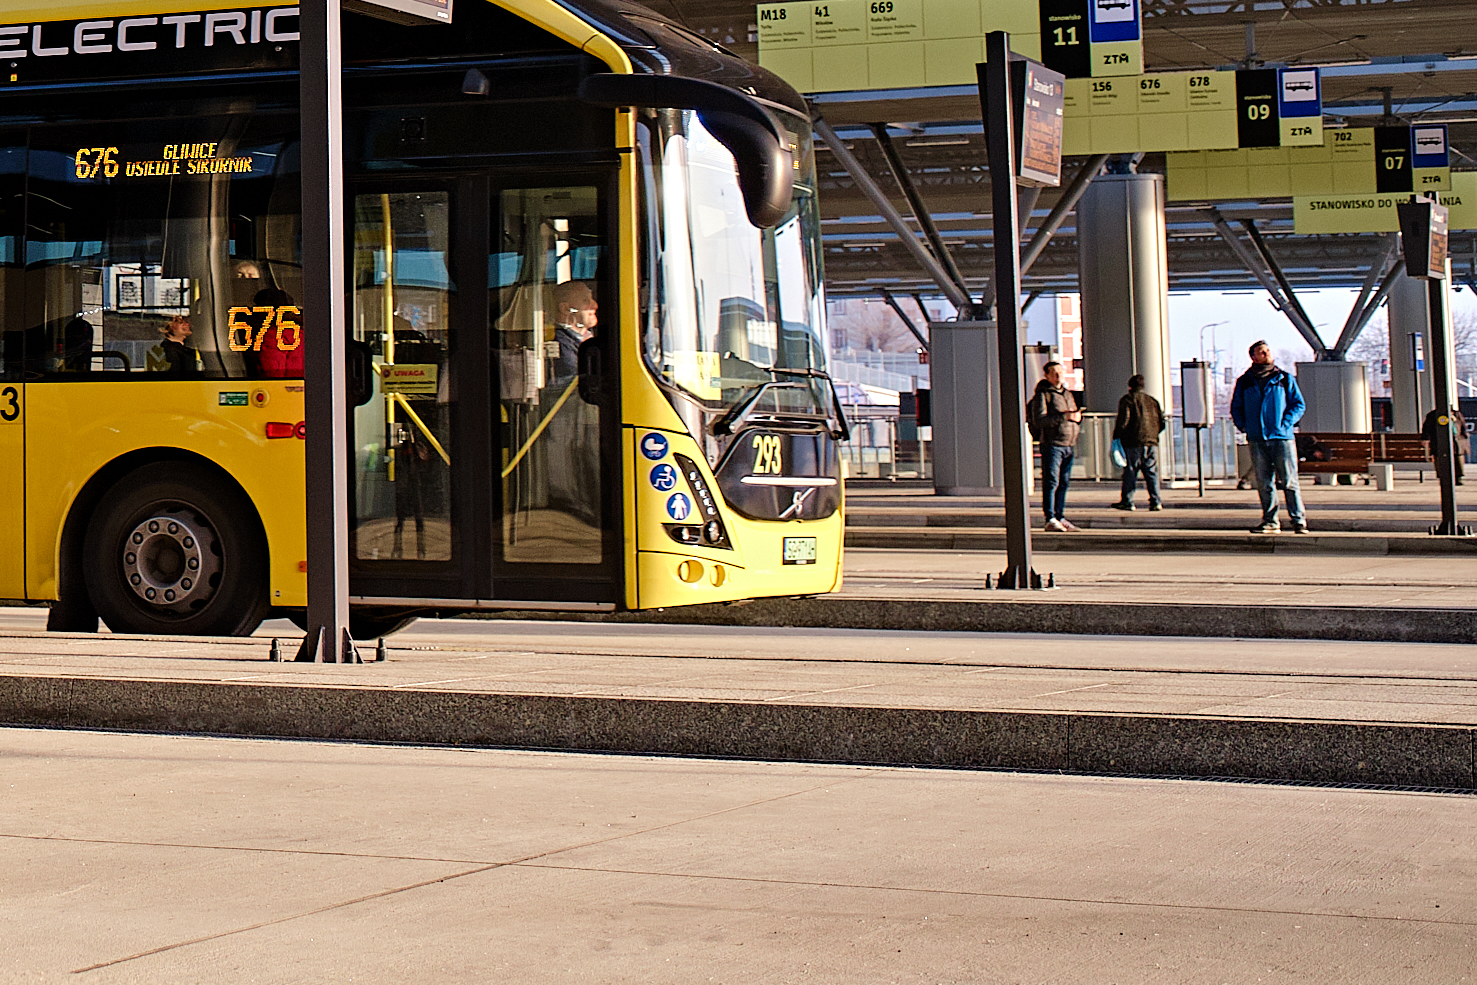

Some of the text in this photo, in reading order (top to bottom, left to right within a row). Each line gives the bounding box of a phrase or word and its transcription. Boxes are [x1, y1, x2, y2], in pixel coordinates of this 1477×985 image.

[814, 6, 830, 17] 41
[870, 2, 894, 14] 669
[760, 8, 786, 21] M18
[1053, 26, 1080, 46] 11
[1104, 53, 1129, 64] ZTM
[1092, 82, 1112, 92] 156
[1140, 79, 1160, 90] 676
[1189, 76, 1210, 87] 678
[1248, 104, 1270, 120] 09
[1334, 132, 1352, 141] 702
[75, 146, 120, 180] 676
[1385, 156, 1404, 170] 07
[1310, 199, 1374, 210] STANOWISKO
[1378, 198, 1392, 208] DO
[228, 306, 300, 352] 676
[752, 434, 782, 474] 293
